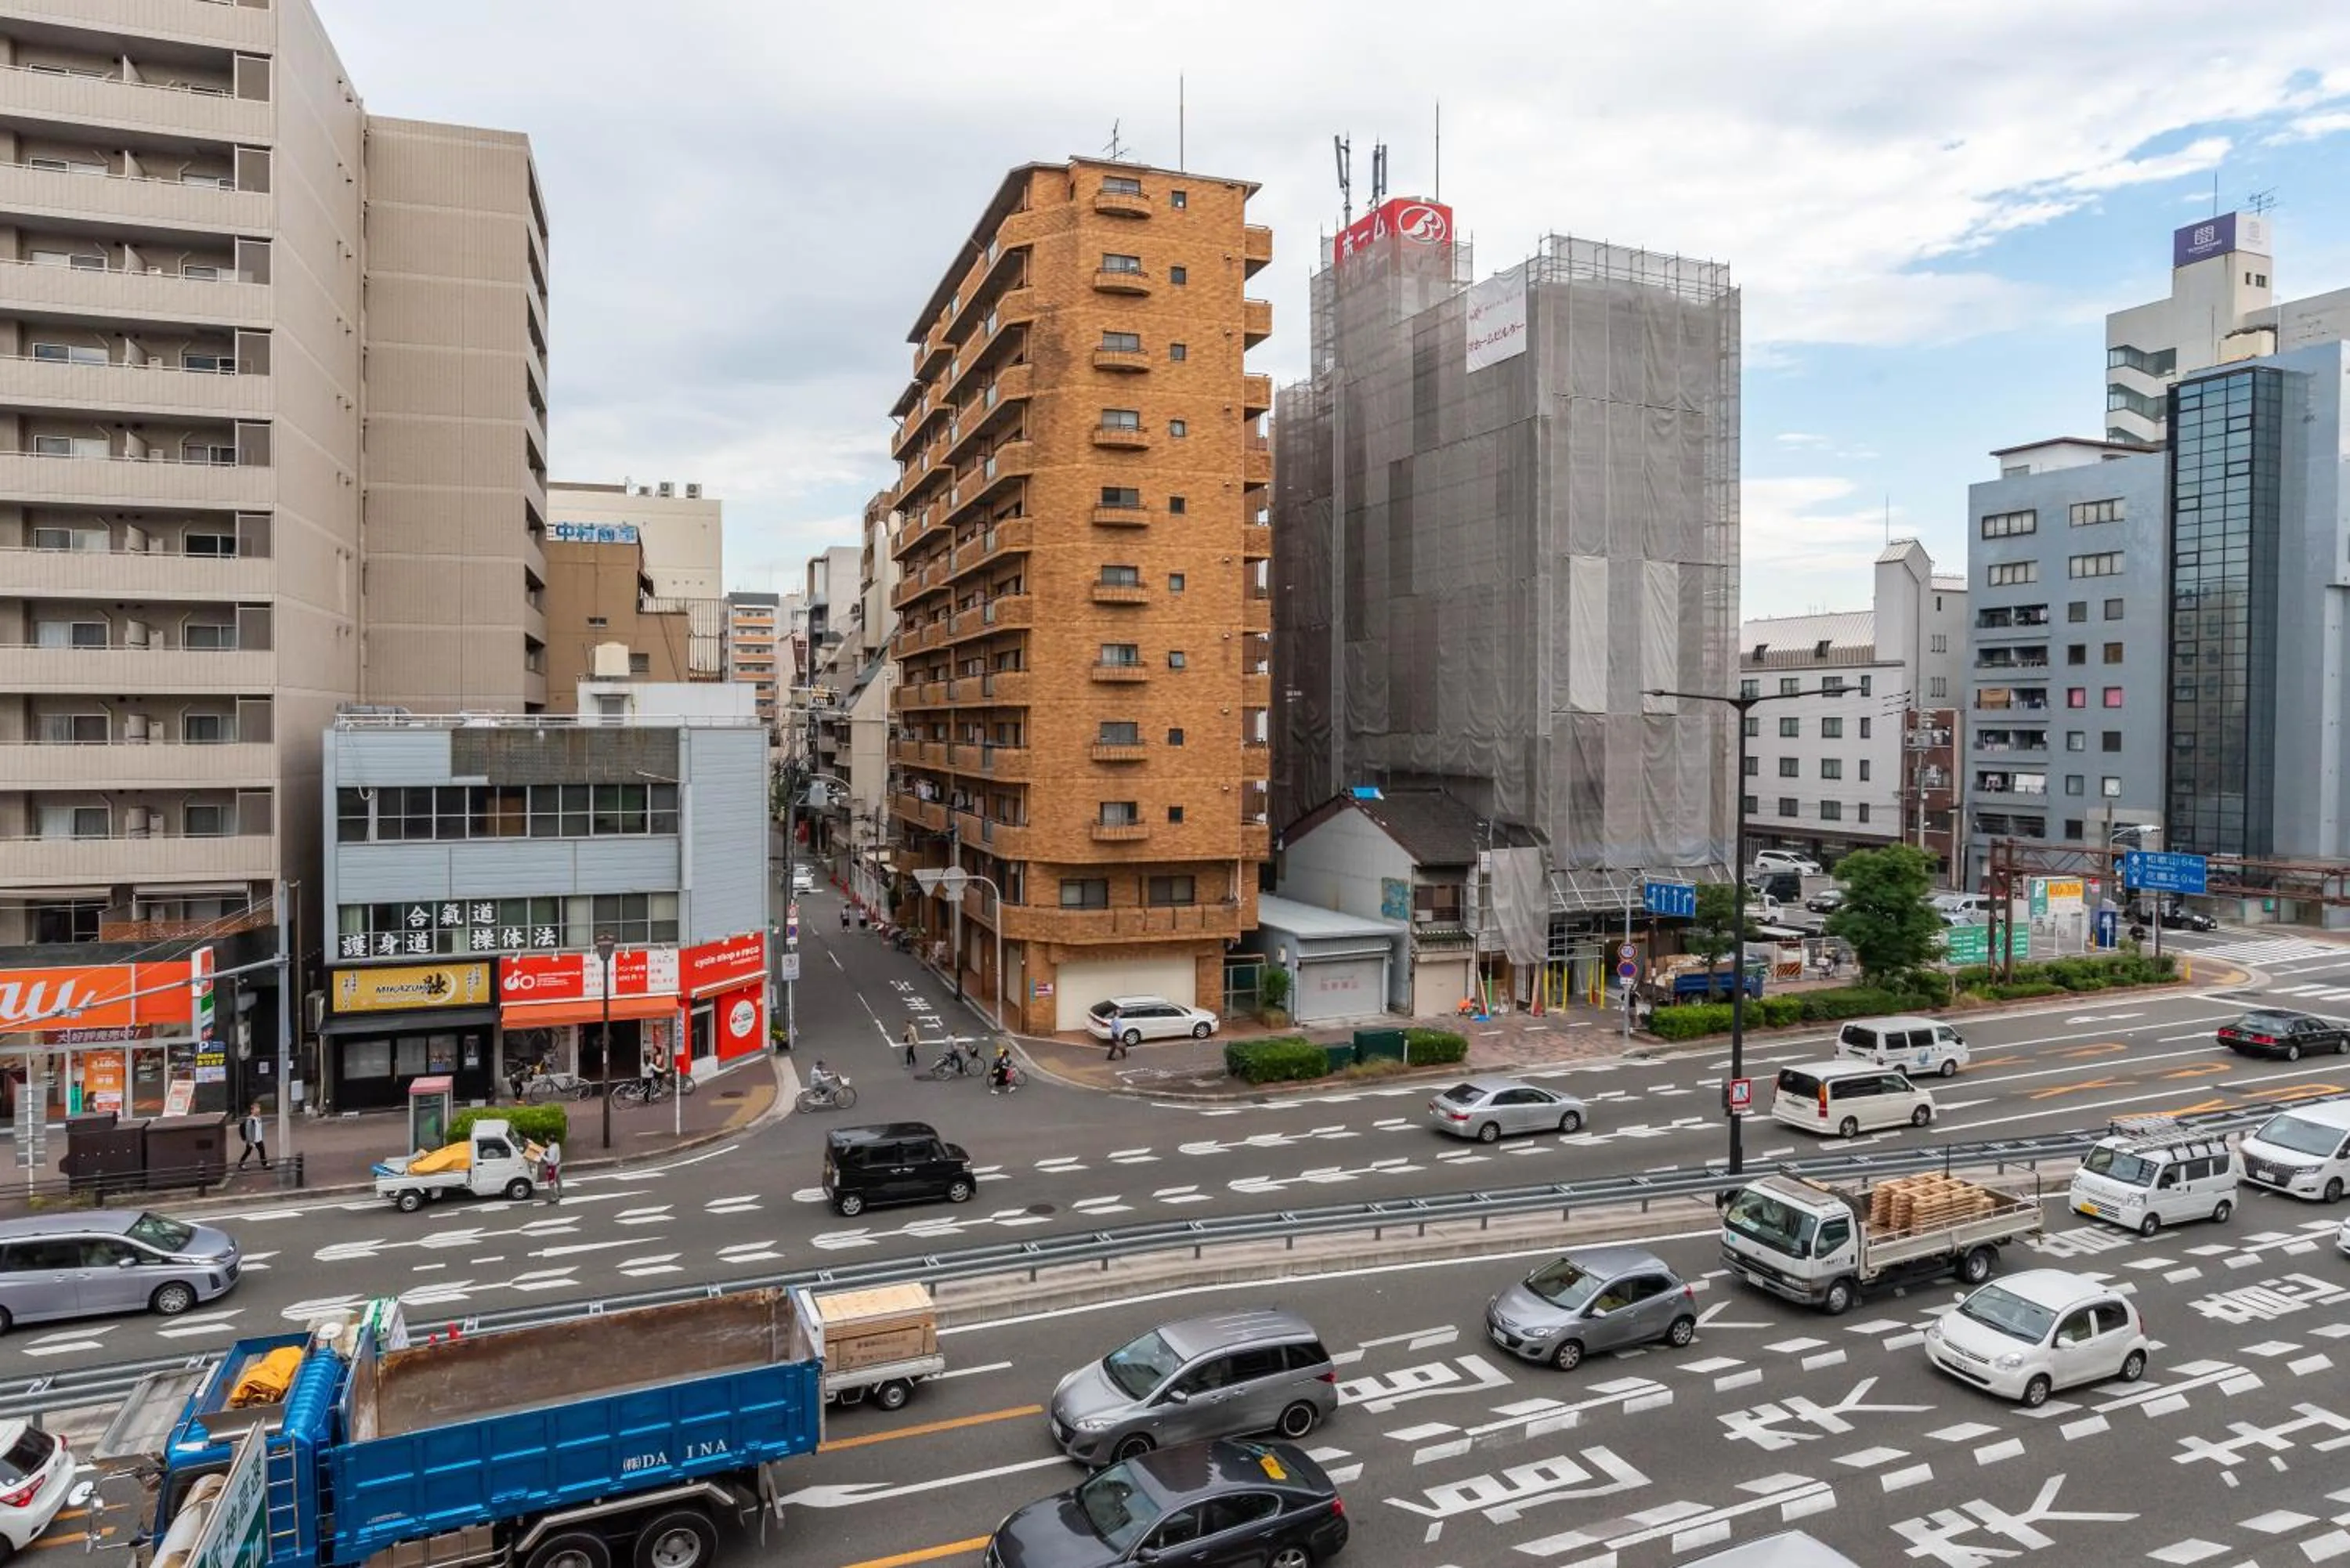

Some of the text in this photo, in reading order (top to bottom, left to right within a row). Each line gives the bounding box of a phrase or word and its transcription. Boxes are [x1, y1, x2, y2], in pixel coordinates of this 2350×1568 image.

[407, 903, 496, 928] 合氣道
[342, 927, 557, 957] 護身道 操体法
[199, 1042, 209, 1053] P
